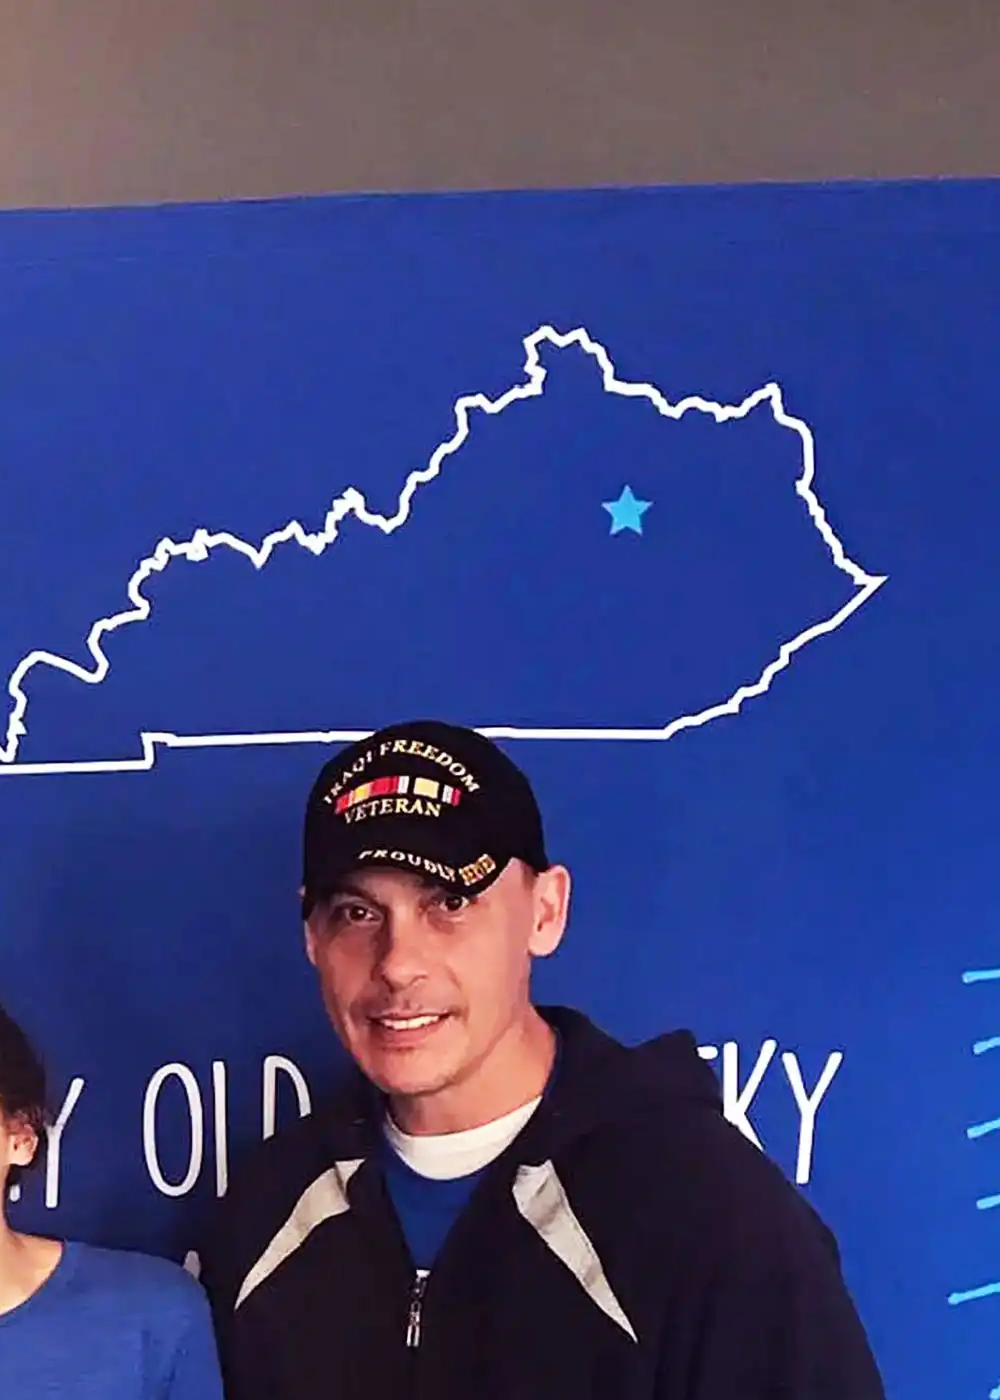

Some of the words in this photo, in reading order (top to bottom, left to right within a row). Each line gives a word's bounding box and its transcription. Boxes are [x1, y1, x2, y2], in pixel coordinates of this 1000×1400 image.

[324, 751, 372, 804] IRAQI
[380, 739, 480, 793] FREEDOM
[344, 797, 441, 824] VETERAN
